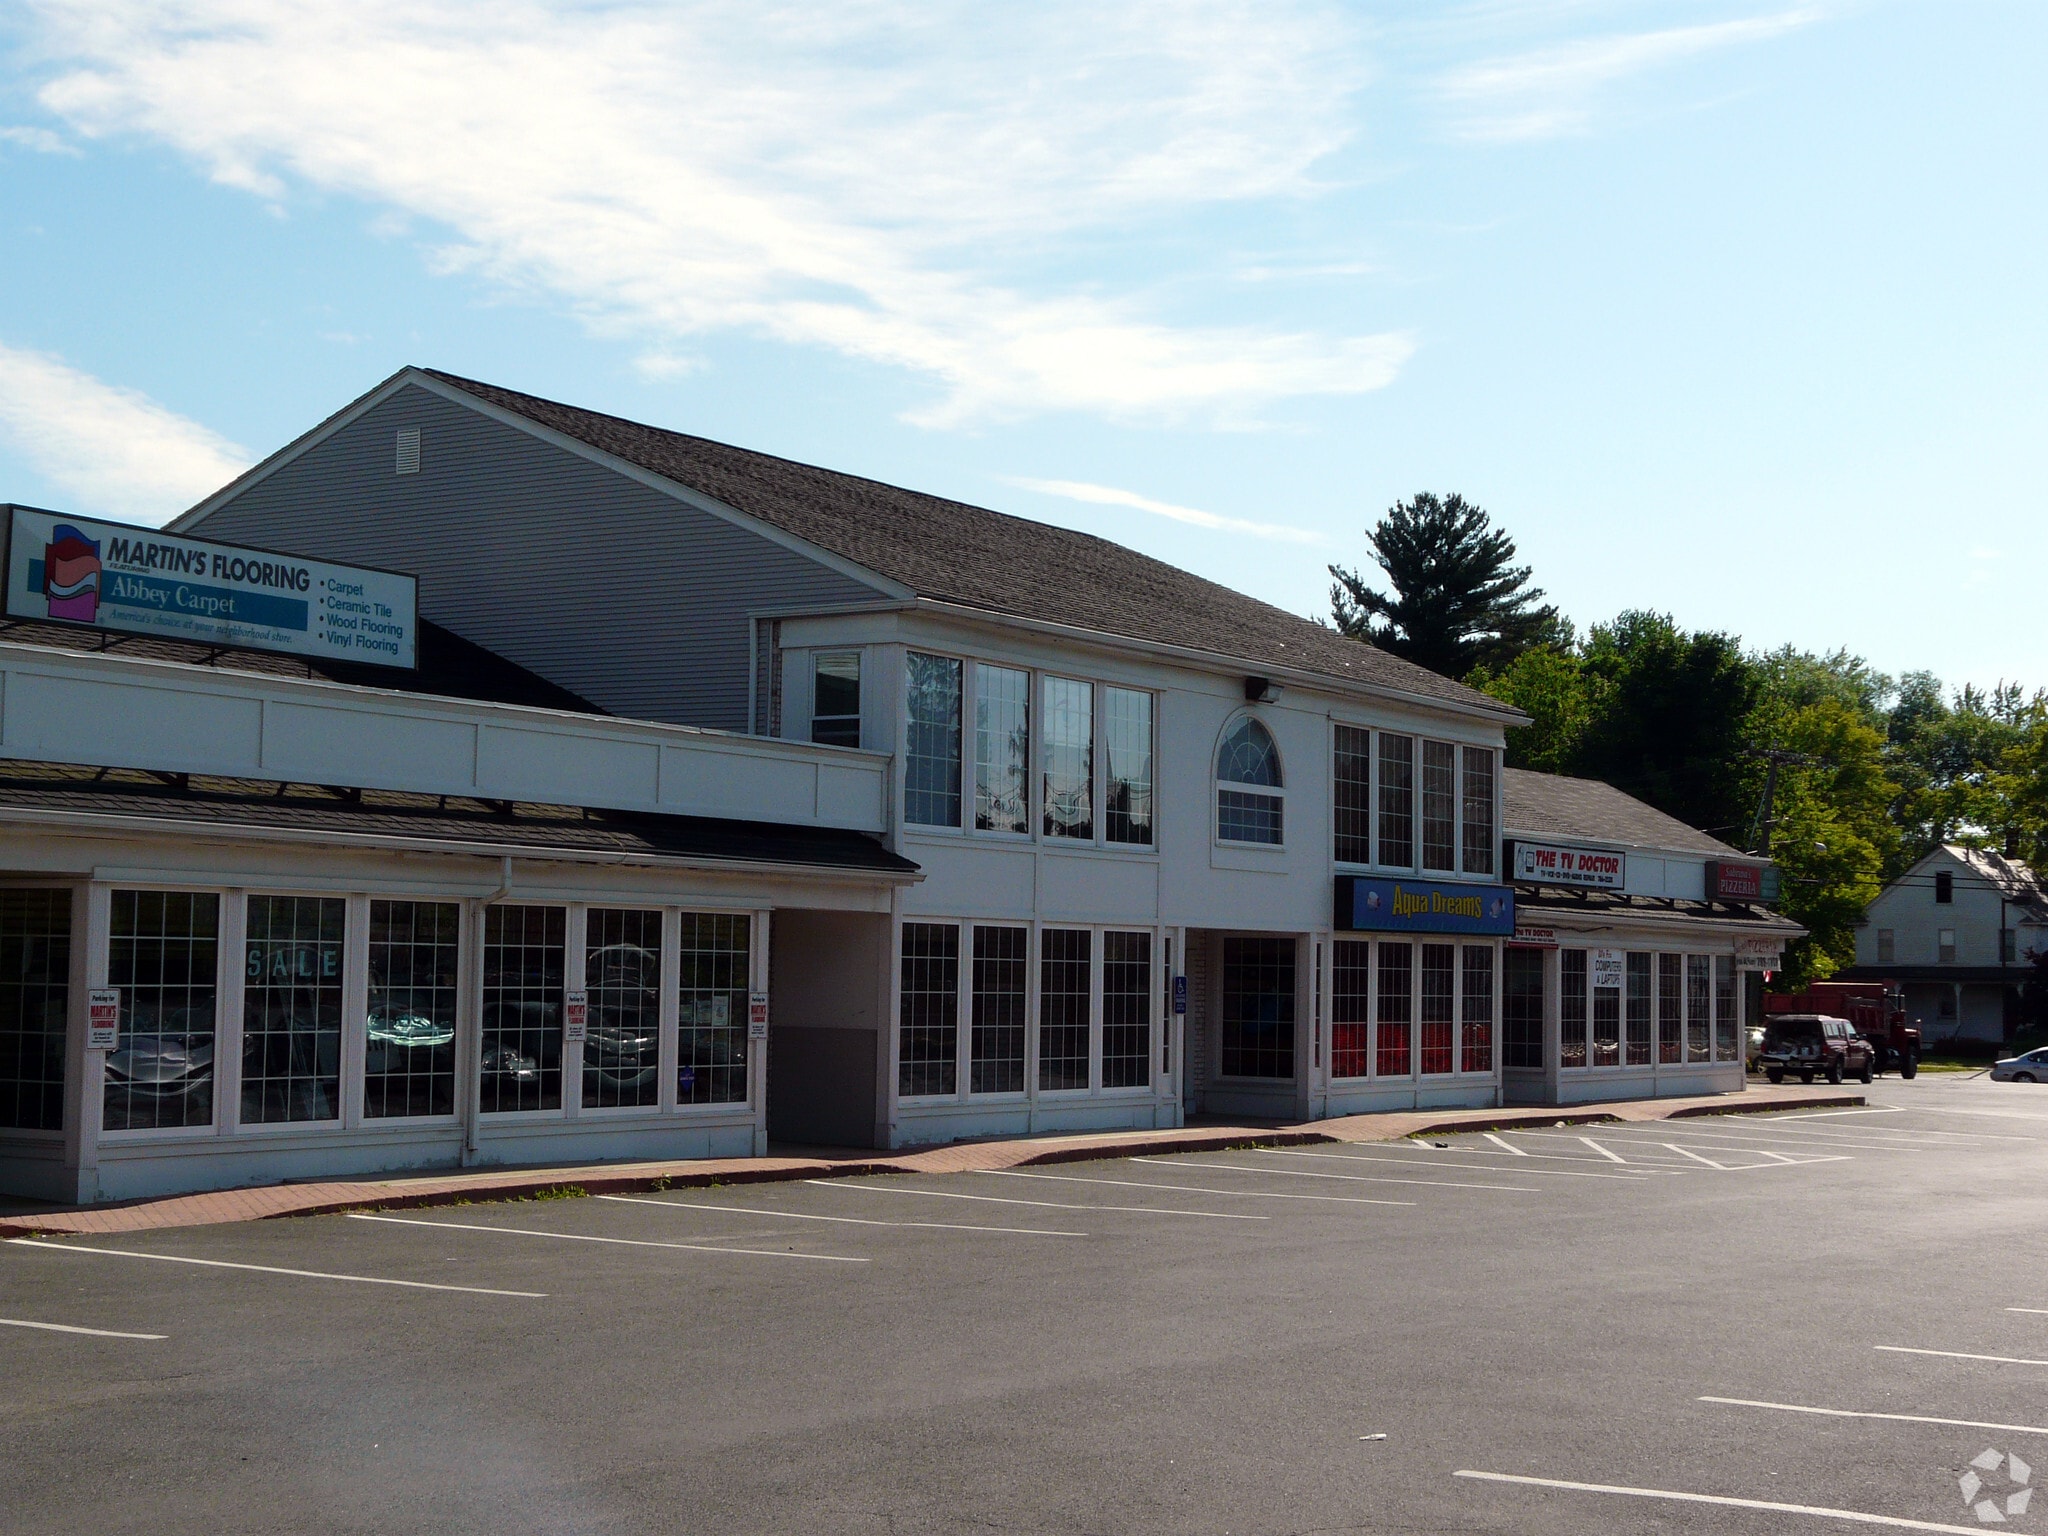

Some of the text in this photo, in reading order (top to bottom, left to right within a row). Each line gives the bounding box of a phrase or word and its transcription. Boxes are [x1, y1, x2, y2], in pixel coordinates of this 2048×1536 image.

[107, 537, 311, 592] MARTIN'S FLOORING
[109, 563, 150, 574] FEATURING
[111, 575, 235, 615] Abbey Carpet
[327, 578, 364, 596] Carpet
[327, 596, 392, 617] Ceramic Tile
[109, 609, 154, 624] America's
[182, 619, 193, 630] at
[194, 622, 214, 635] your
[216, 623, 270, 640] neighborhood
[327, 613, 403, 639] Wood Flooring
[327, 630, 398, 655] Vinyl Flooring
[1536, 850, 1619, 874] THE TV DOCTOR
[1720, 880, 1756, 895] PIZZERIA
[1392, 885, 1482, 919] Aqua Dreams
[1533, 929, 1554, 937] DOCTOR
[248, 949, 337, 977] SALE
[91, 1005, 116, 1018] MARTIN'S
